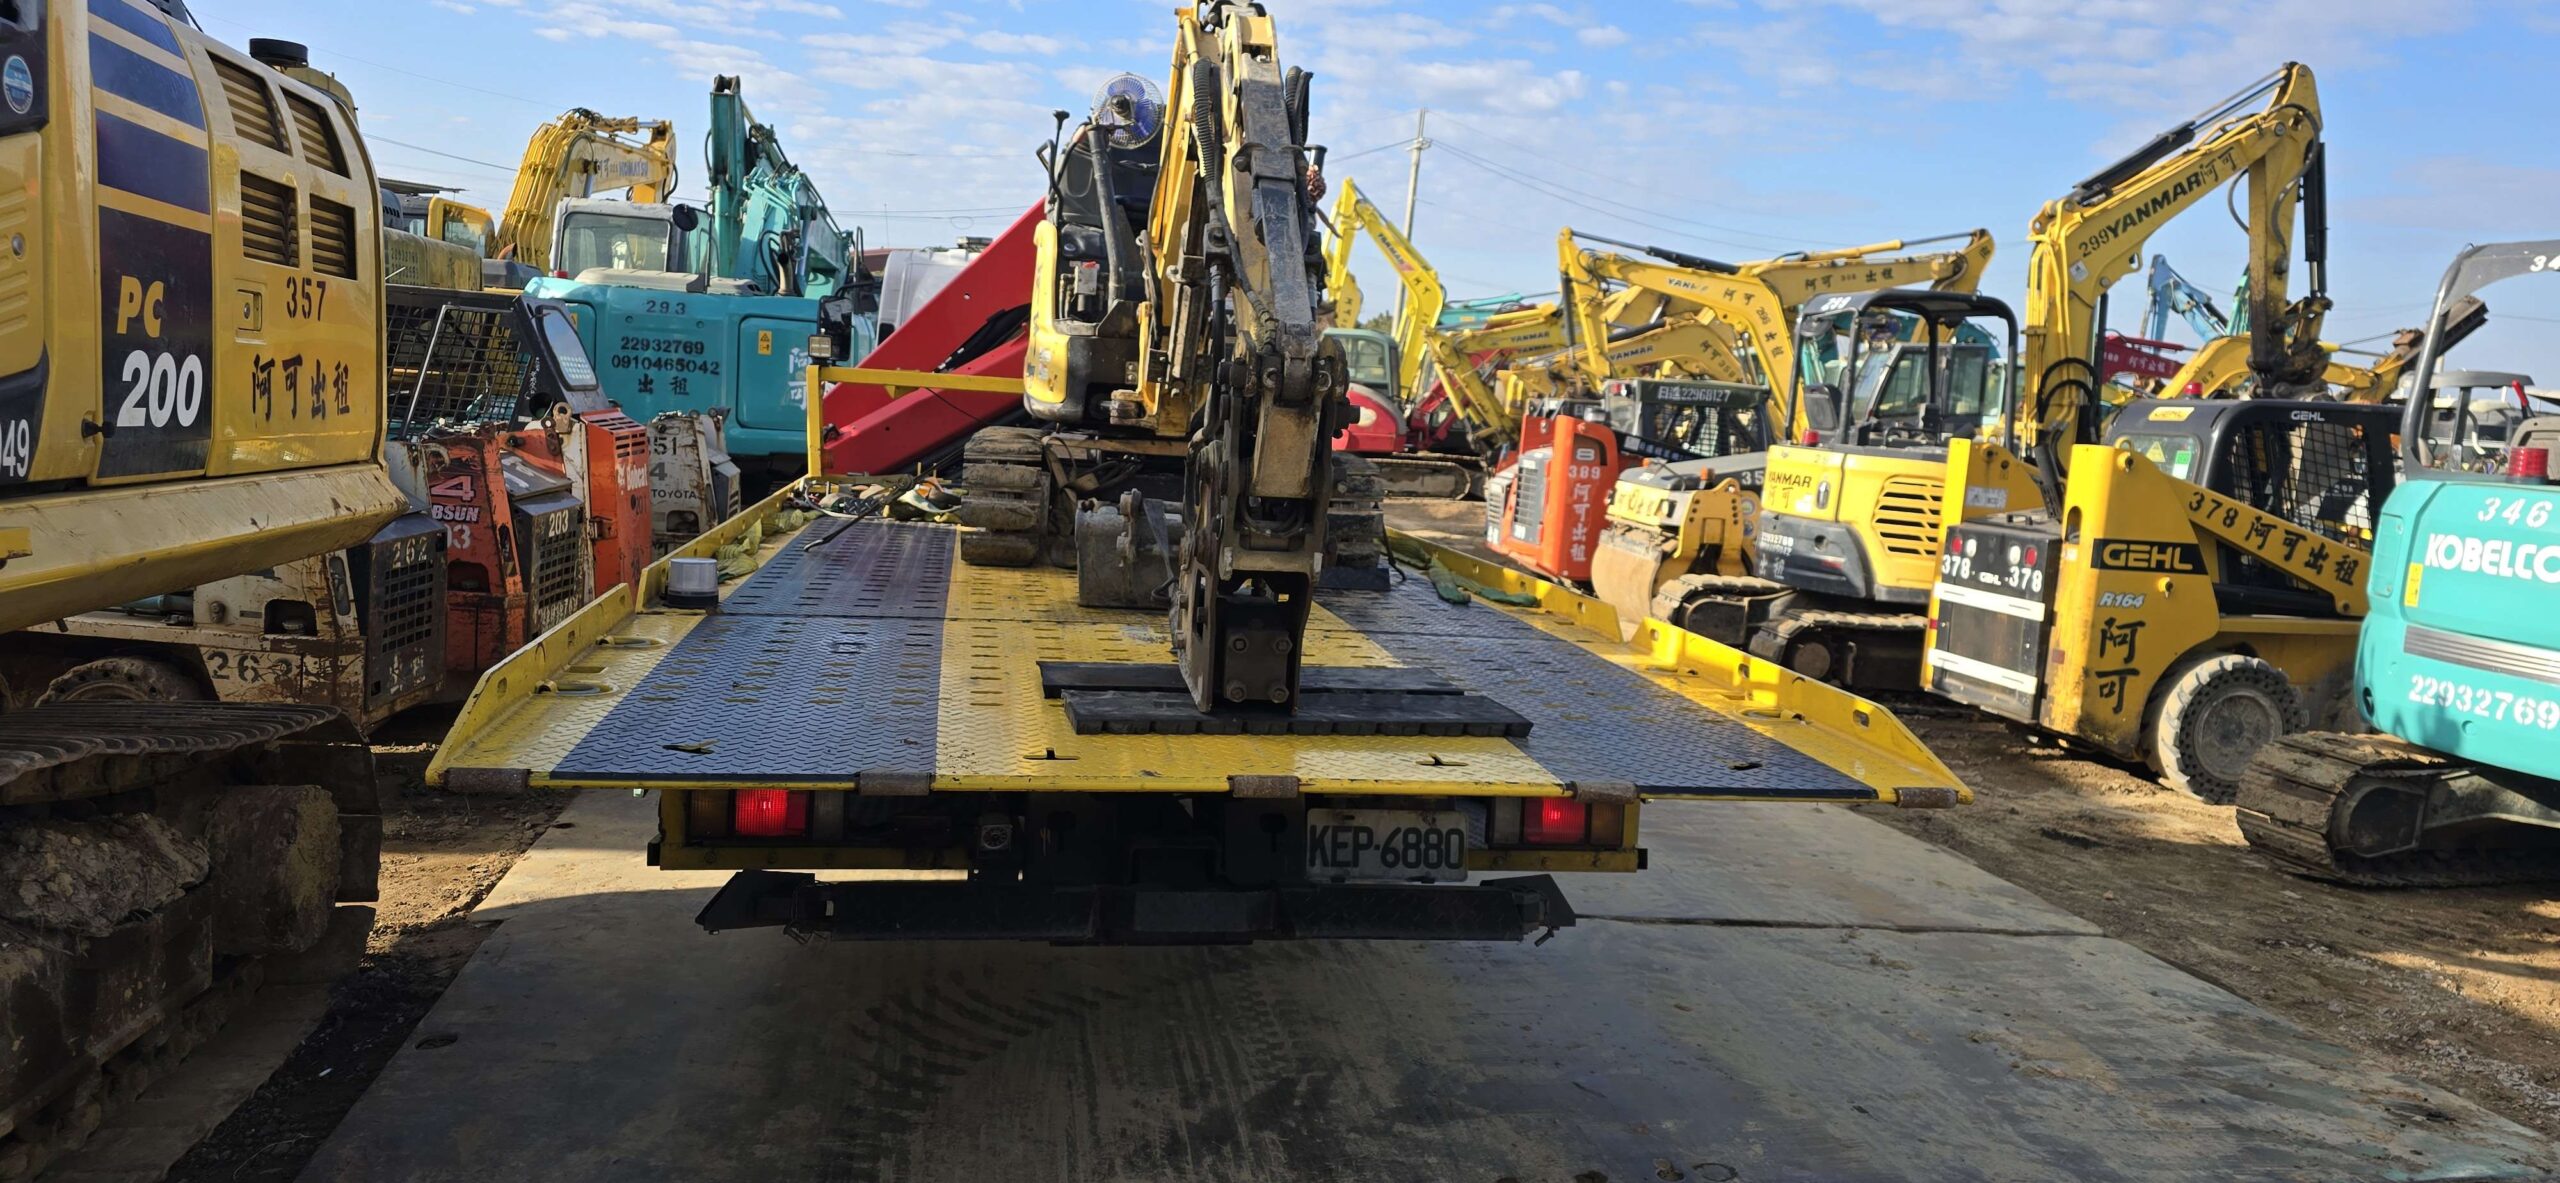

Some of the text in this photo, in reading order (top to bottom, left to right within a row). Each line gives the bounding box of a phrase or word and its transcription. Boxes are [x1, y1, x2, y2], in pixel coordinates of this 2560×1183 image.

[2079, 146, 2238, 257] 299 YANMAR 阿可
[117, 275, 164, 338] PC
[287, 276, 326, 321] 357
[646, 300, 686, 315] 293
[620, 336, 705, 355] 22932769
[1609, 345, 1654, 361] YANMAR
[611, 354, 720, 376] 0910465042
[116, 349, 203, 428] 200
[252, 353, 350, 422] 阿可出租
[637, 373, 690, 396] 出租
[2291, 411, 2325, 422] GEHL
[1568, 465, 1600, 479] 389
[651, 489, 697, 499] TOYOTA
[548, 509, 569, 537] 203
[2477, 497, 2553, 528] 346
[2188, 491, 2360, 586] 378 阿可出租
[2103, 543, 2193, 571] GEHL
[1942, 554, 1971, 580] 378
[2009, 566, 2043, 593] 378
[2100, 592, 2145, 608] R164
[2095, 616, 2147, 715] 阿可
[2408, 674, 2560, 730] 22932769
